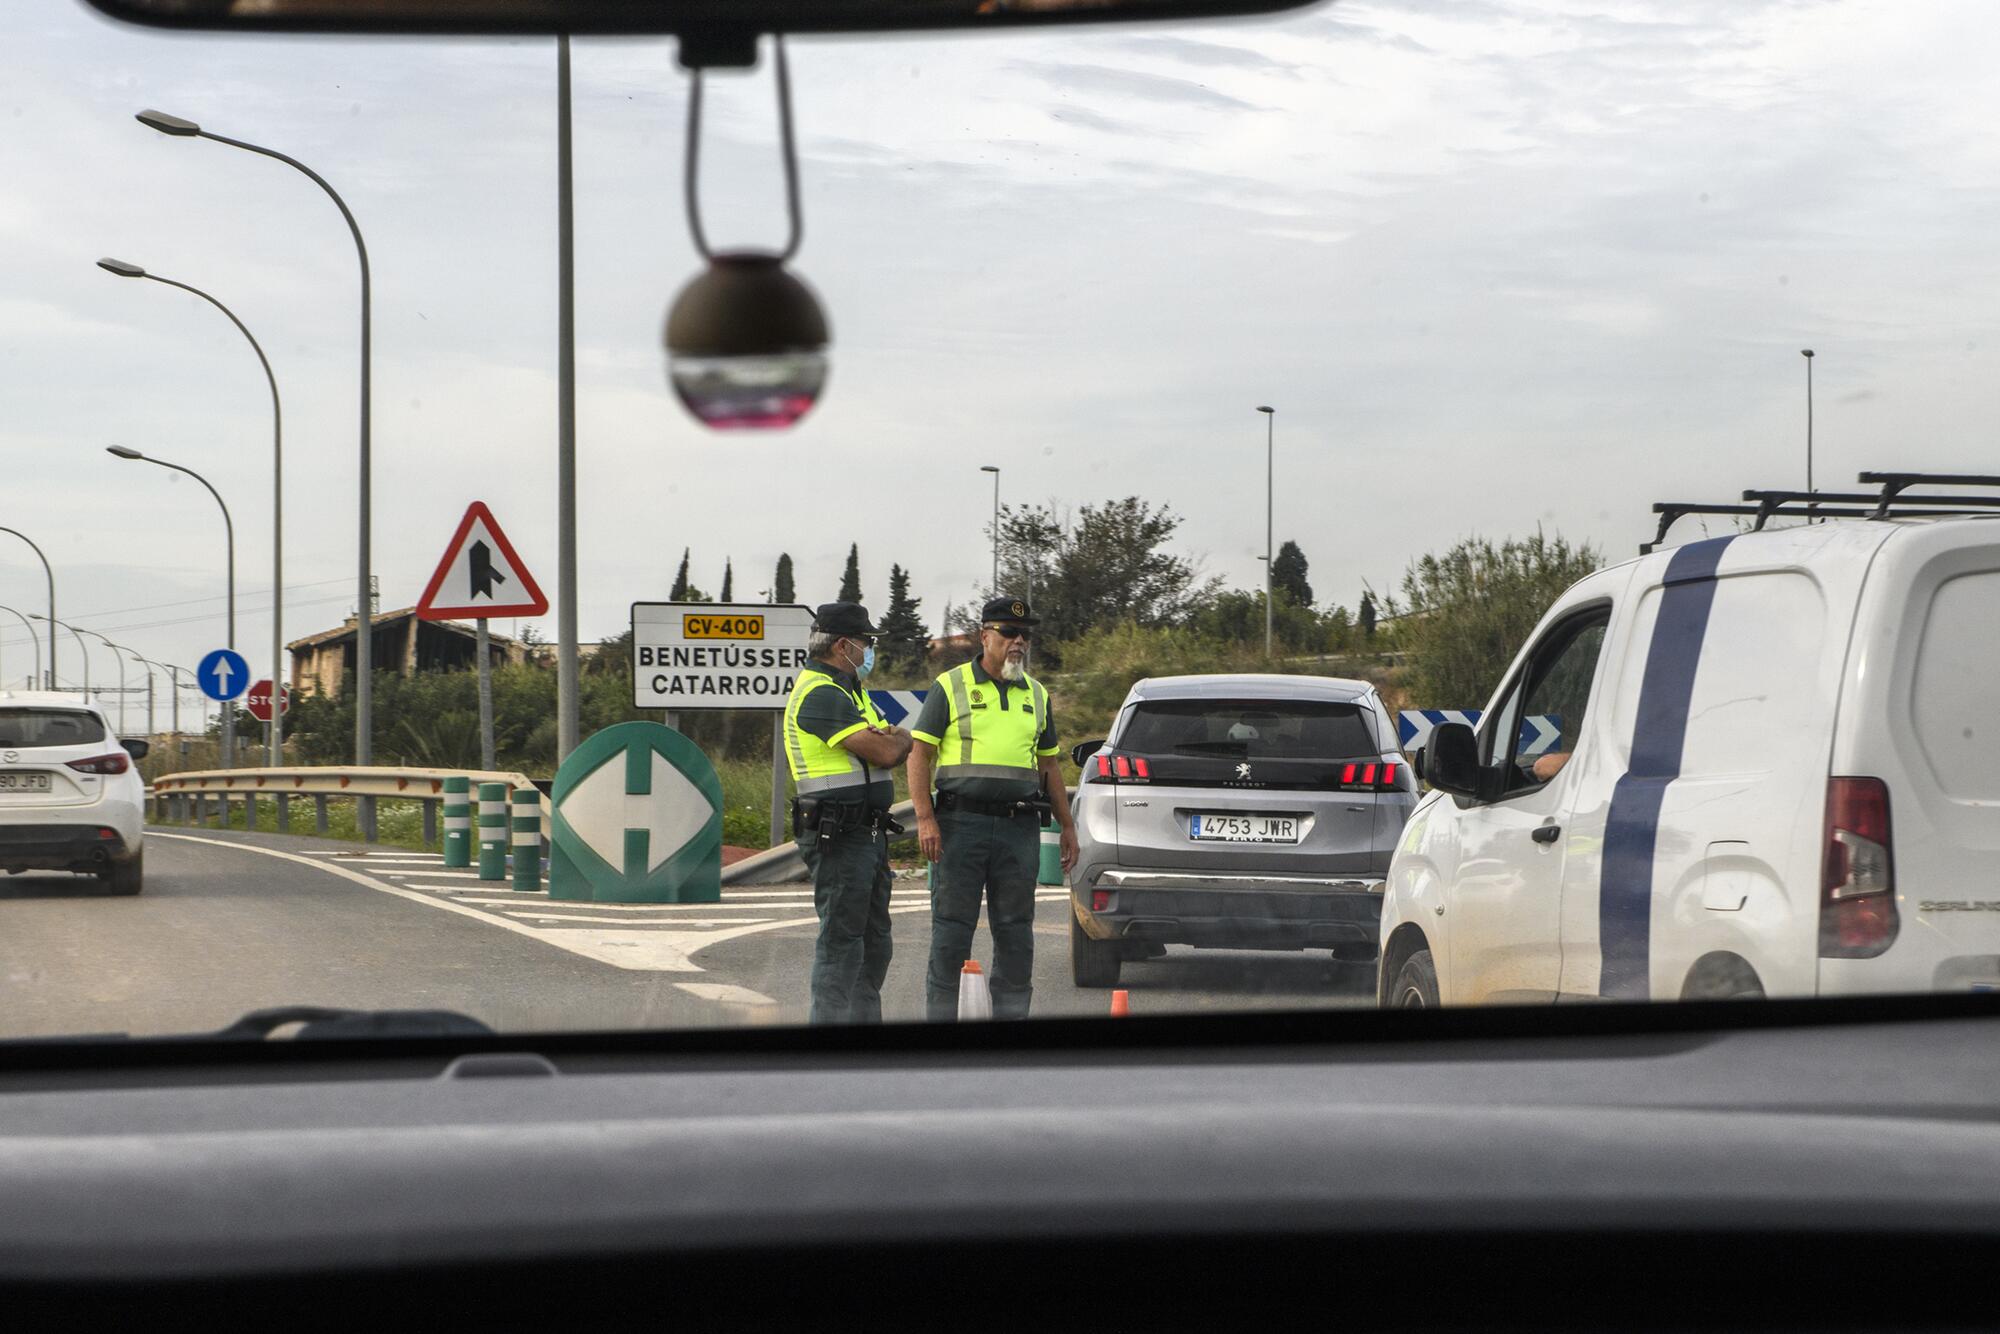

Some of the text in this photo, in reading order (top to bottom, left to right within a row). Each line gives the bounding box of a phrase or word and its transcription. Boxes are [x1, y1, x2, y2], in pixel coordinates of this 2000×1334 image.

[687, 618, 760, 635] CV-400
[639, 643, 808, 668] BENETÚSSER
[1204, 817, 1293, 837] 4753 JWR
